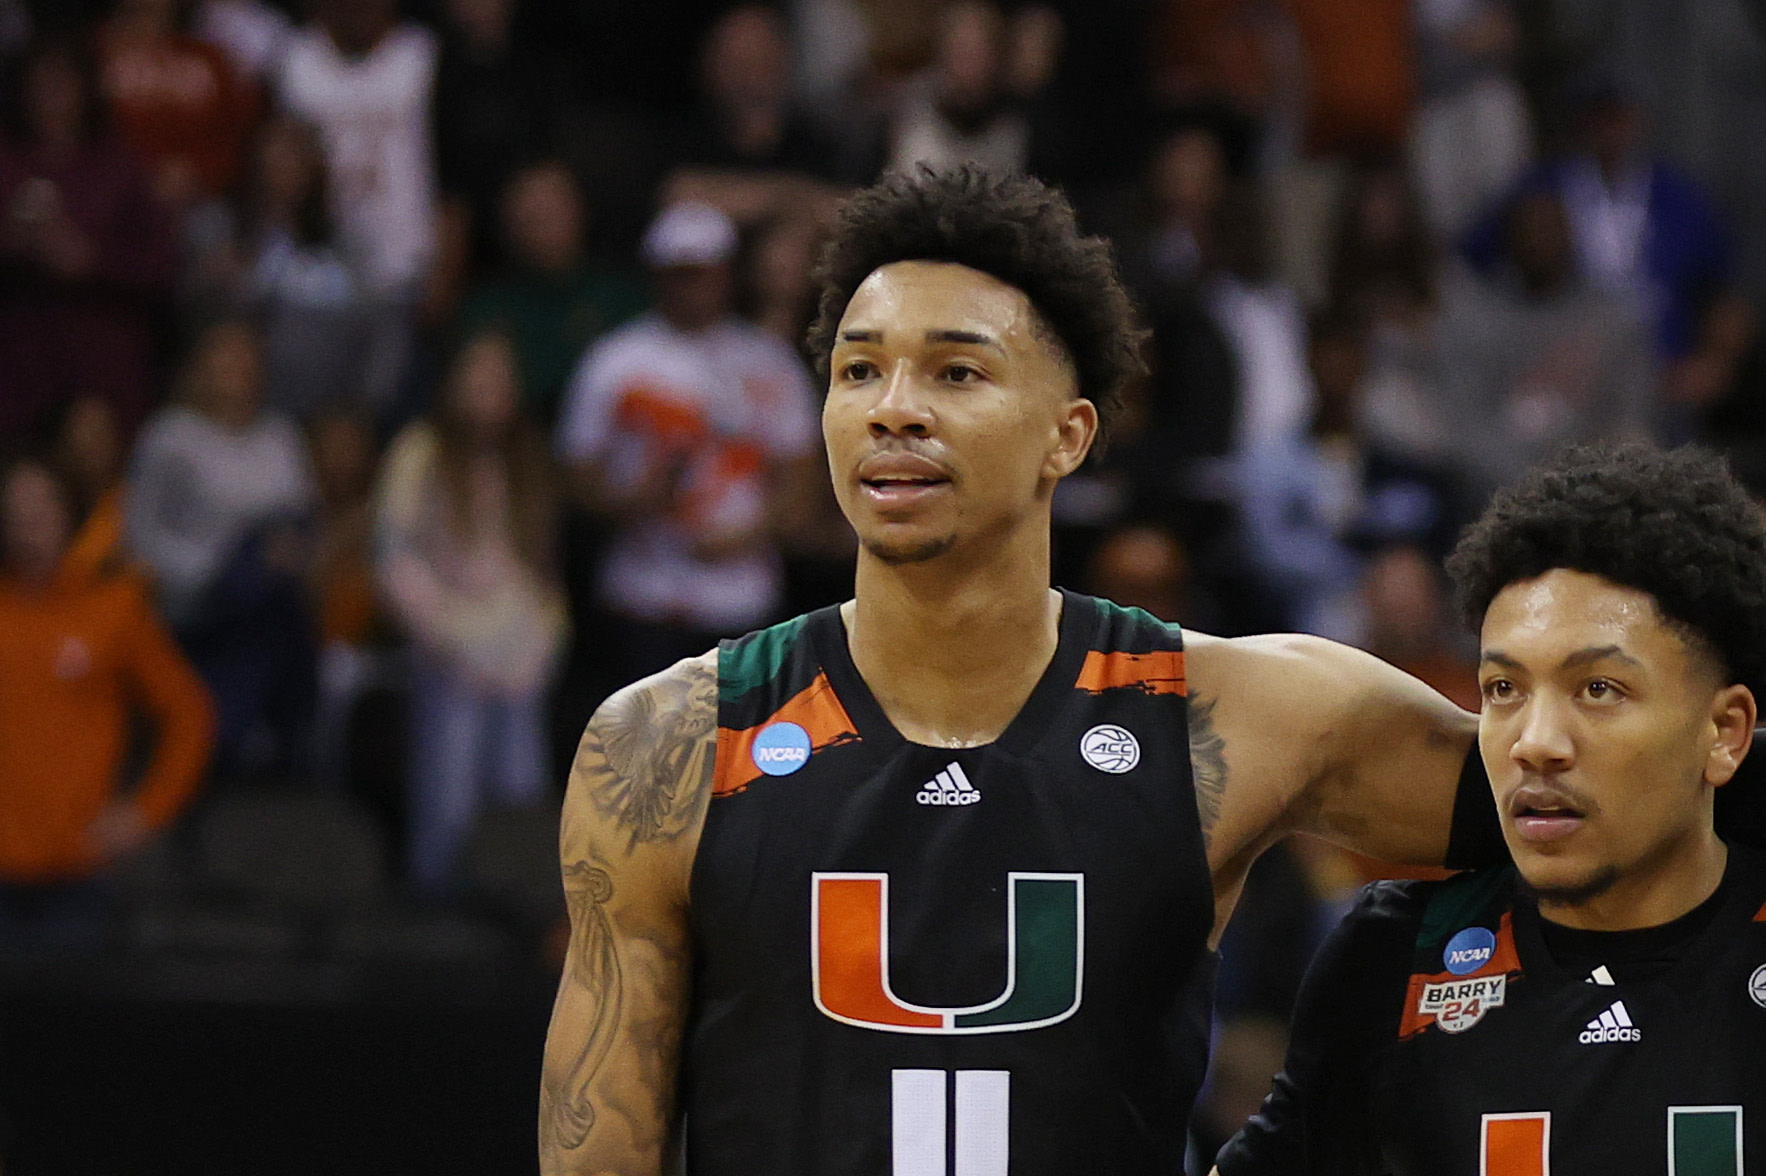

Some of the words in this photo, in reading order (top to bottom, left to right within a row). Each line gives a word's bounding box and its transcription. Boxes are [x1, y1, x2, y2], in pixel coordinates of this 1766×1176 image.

[759, 747, 806, 762] NCAA
[1091, 742, 1133, 754] ACC
[916, 789, 981, 806] adidas
[811, 871, 1084, 1035] U
[1449, 947, 1491, 965] NCAA
[1427, 979, 1504, 1003] BARRY
[1442, 998, 1481, 1022] 24
[1579, 1026, 1642, 1044] adidas
